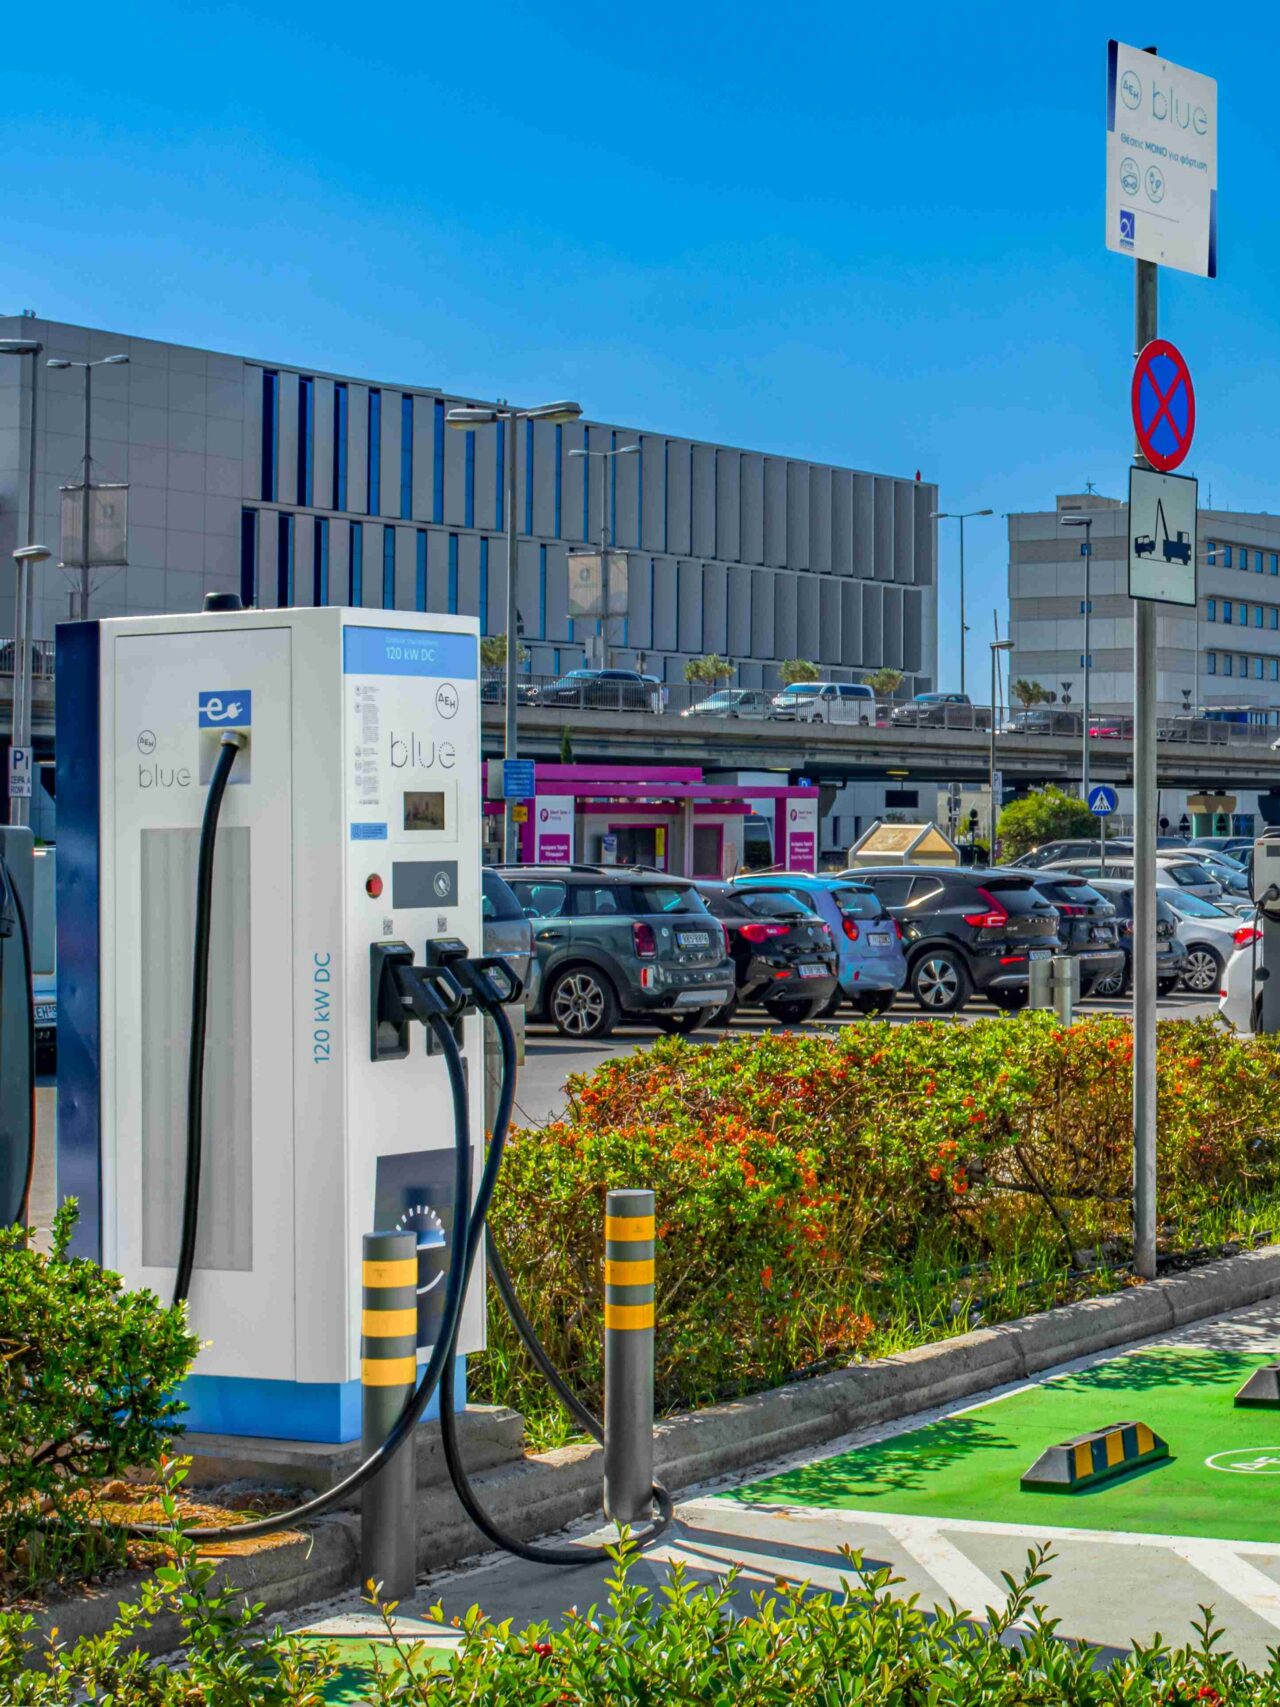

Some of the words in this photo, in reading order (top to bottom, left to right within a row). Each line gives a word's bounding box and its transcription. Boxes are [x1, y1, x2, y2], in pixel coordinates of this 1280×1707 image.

[1152, 79, 1208, 136] blue
[385, 646, 402, 660] 120
[403, 647, 420, 661] kW
[420, 648, 436, 662] DC
[438, 692, 456, 709] ΔΕΗ
[390, 730, 456, 769] blue
[138, 762, 192, 788] blue
[313, 952, 331, 982] DC
[313, 988, 331, 1021] kW
[313, 1028, 331, 1064] 120
